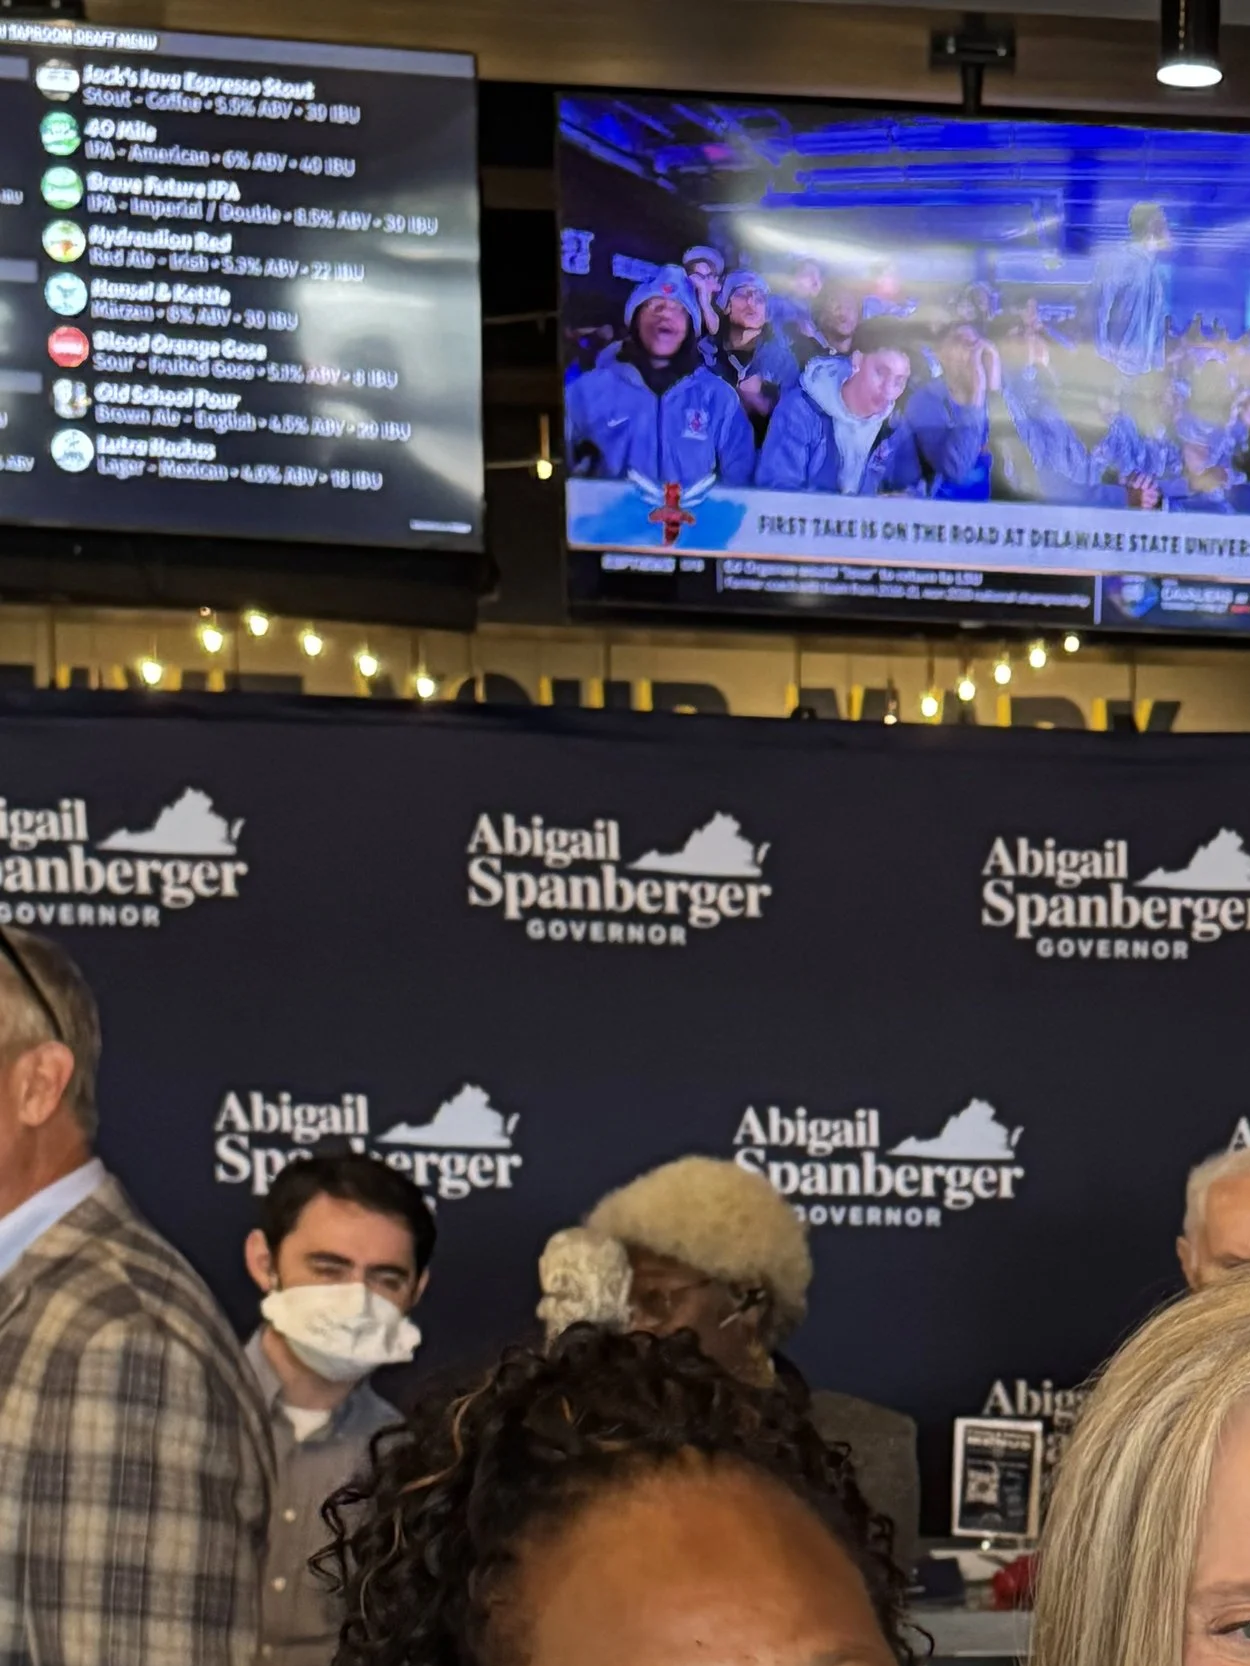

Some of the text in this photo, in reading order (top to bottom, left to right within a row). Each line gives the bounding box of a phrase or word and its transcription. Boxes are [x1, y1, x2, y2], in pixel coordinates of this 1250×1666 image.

[261, 76, 315, 100] Stout
[759, 514, 806, 536] FIRST
[812, 517, 857, 538] TAKE
[860, 519, 877, 539] IS
[881, 520, 907, 541] ON
[912, 522, 946, 543] THE
[951, 524, 1000, 545] ROAD
[1003, 527, 1024, 546] AT
[1030, 528, 1124, 551] DELAWARE
[1128, 533, 1181, 554] STATE
[0, 797, 89, 851] igail
[466, 812, 621, 868] Abigail
[0, 844, 248, 908] anberger
[981, 836, 1128, 888] Abigail
[467, 856, 772, 928] Spanberger
[526, 917, 688, 946] GOVERNOR
[1036, 937, 1189, 960] GOVERNOR
[214, 1090, 370, 1144] Abigail
[732, 1105, 881, 1157] Abigail
[214, 1134, 523, 1200] Sperger
